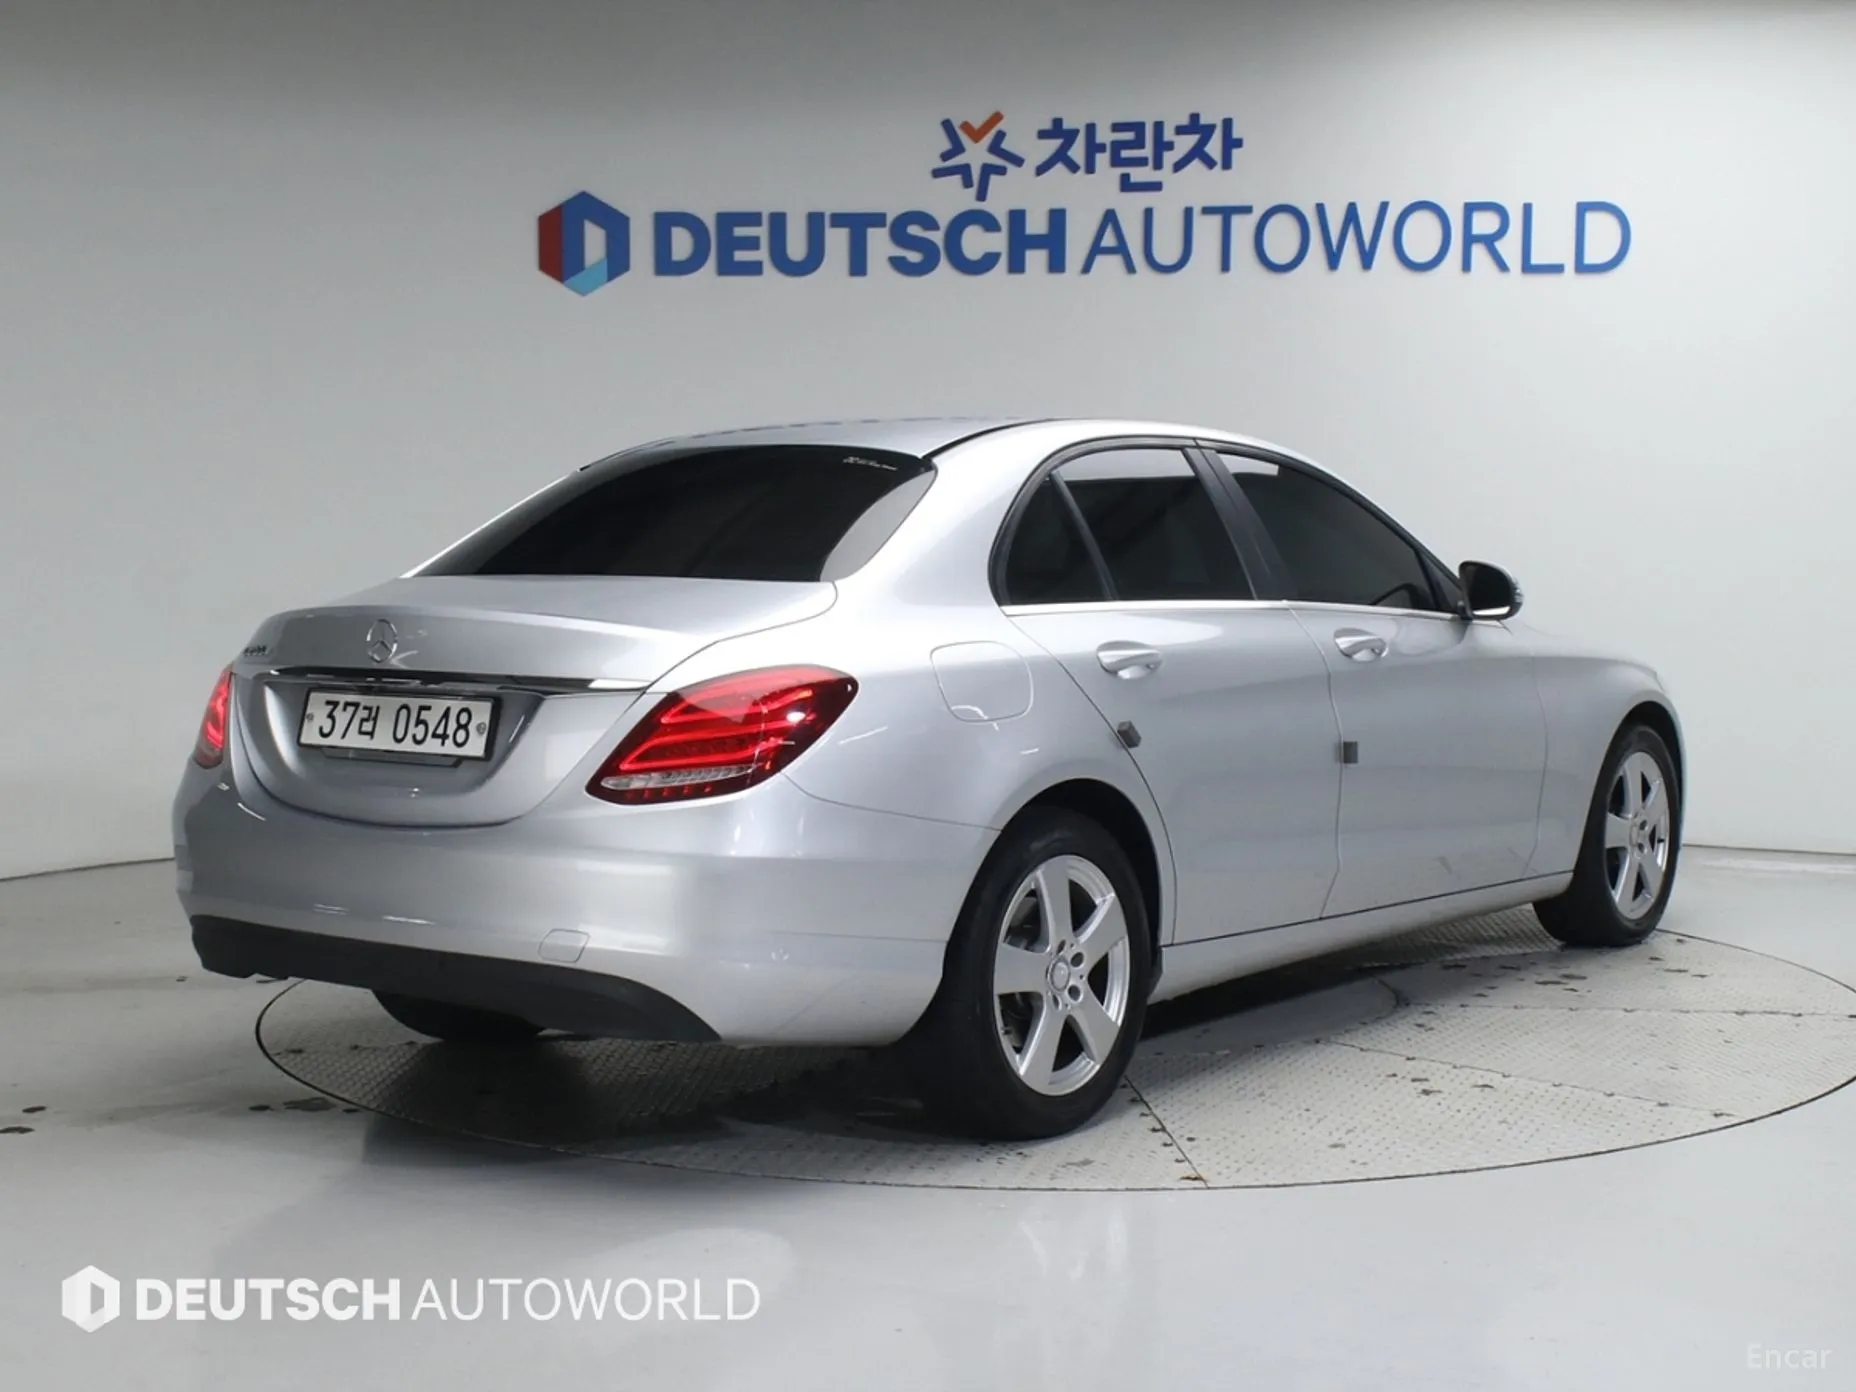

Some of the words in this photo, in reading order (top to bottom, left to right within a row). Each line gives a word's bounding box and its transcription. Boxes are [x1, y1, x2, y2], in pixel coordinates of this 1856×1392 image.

[1035, 112, 1244, 192] 차란차
[653, 207, 1067, 278] DEUTSCH
[1080, 200, 1632, 275] AUTOWORLD
[318, 700, 381, 740] 37러
[392, 703, 473, 748] 0548
